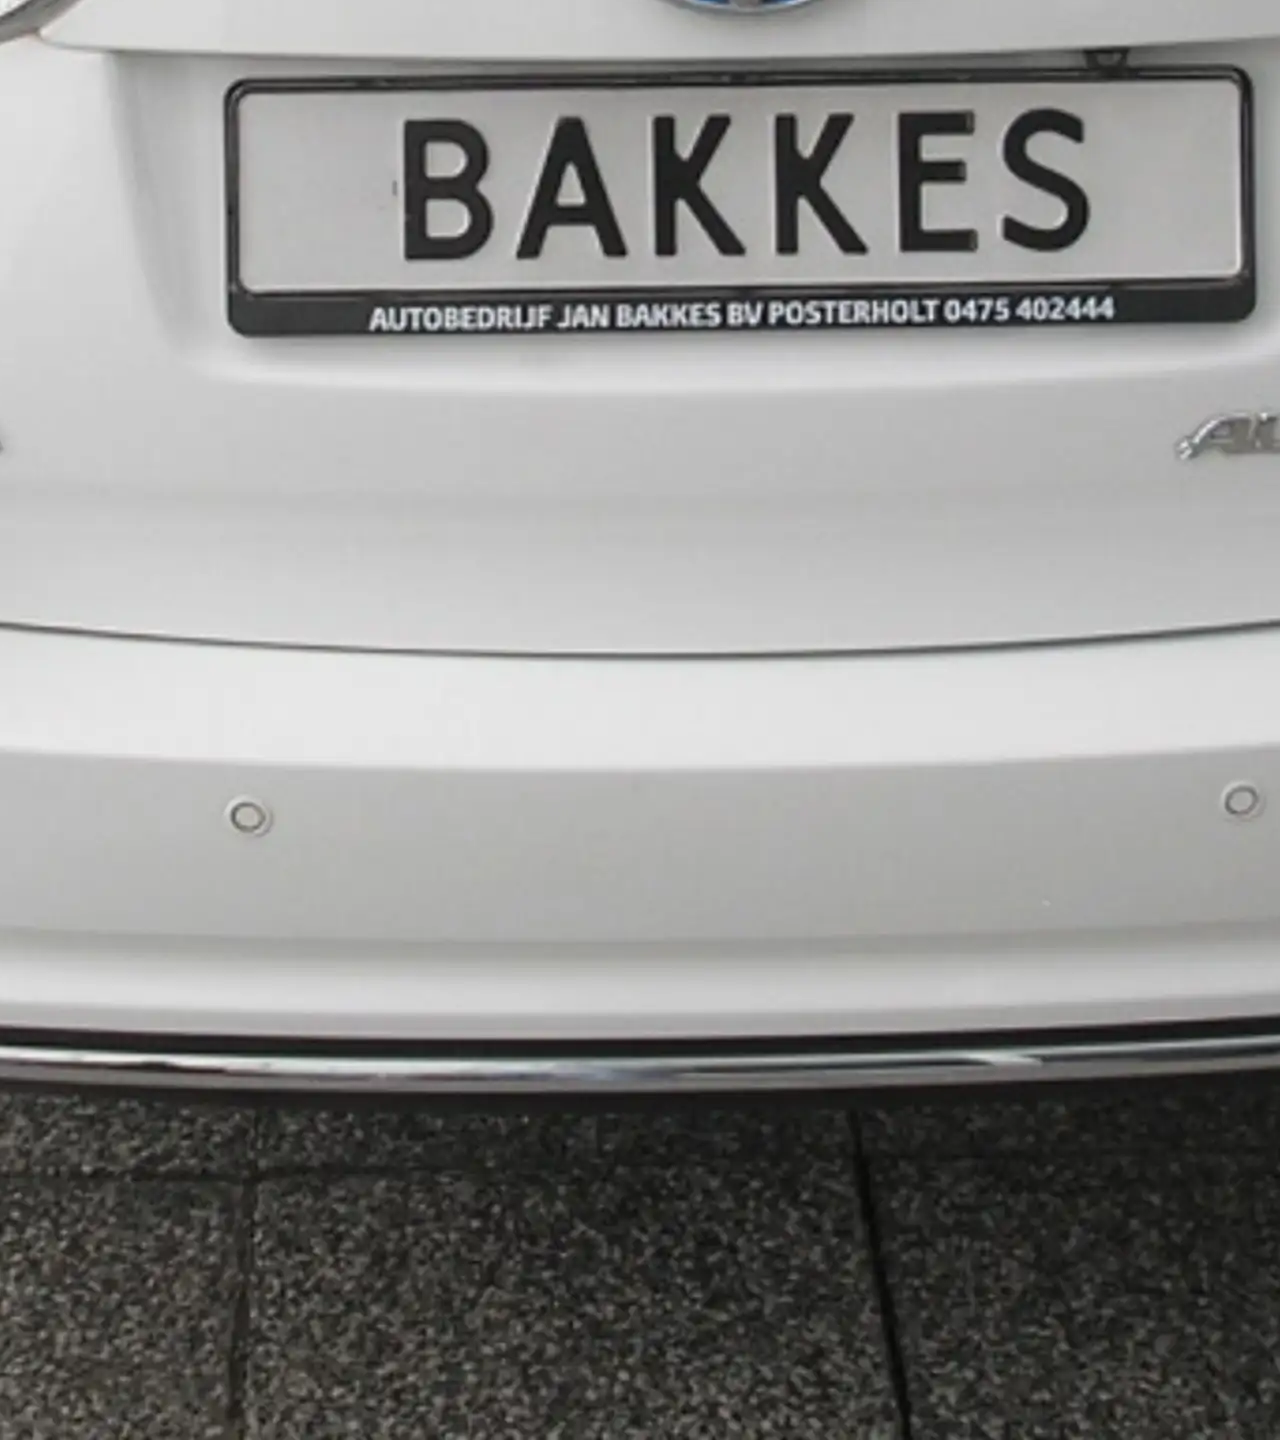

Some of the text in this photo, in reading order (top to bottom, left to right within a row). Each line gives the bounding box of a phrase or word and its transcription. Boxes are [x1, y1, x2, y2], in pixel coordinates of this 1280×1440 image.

[403, 107, 1091, 260] BAKKES
[370, 295, 1115, 332] AUTOBEDRIJF JAN BAKKES BV POSTERHOLT 0475 402444
